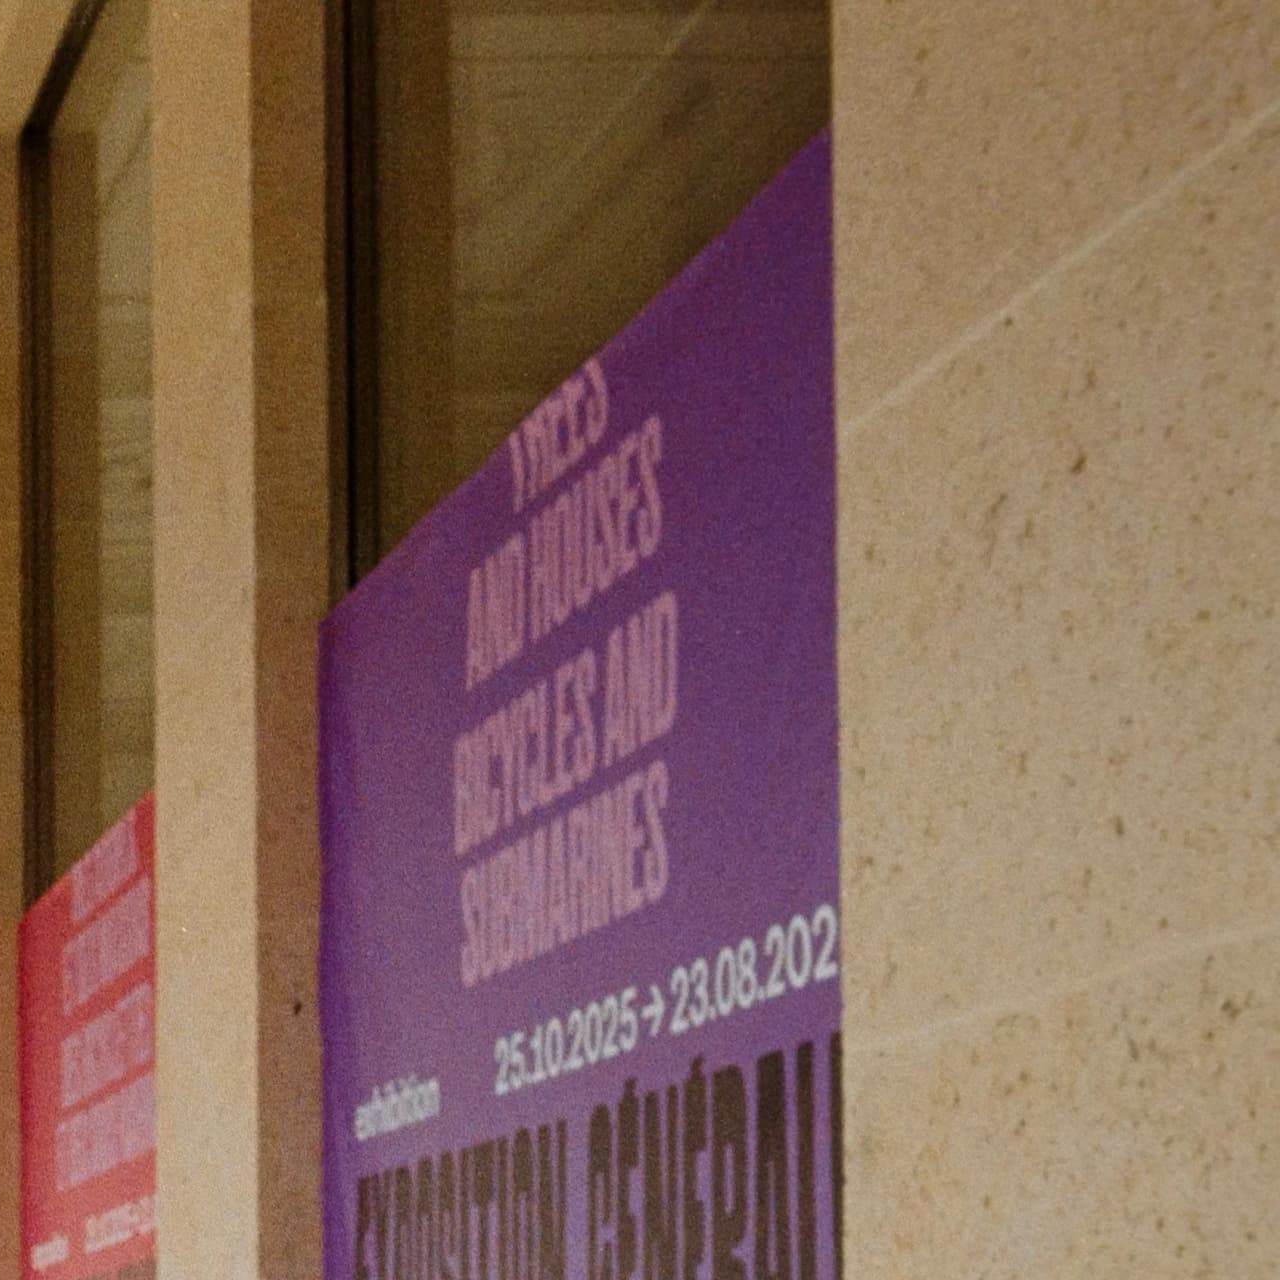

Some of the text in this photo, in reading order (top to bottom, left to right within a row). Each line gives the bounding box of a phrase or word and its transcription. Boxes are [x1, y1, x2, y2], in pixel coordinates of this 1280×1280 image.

[467, 415, 664, 690] AND HOUSES
[454, 591, 678, 857] BICYCLES AND
[459, 760, 668, 987] SUBMARINES
[495, 987, 639, 1095] 25.10.2025
